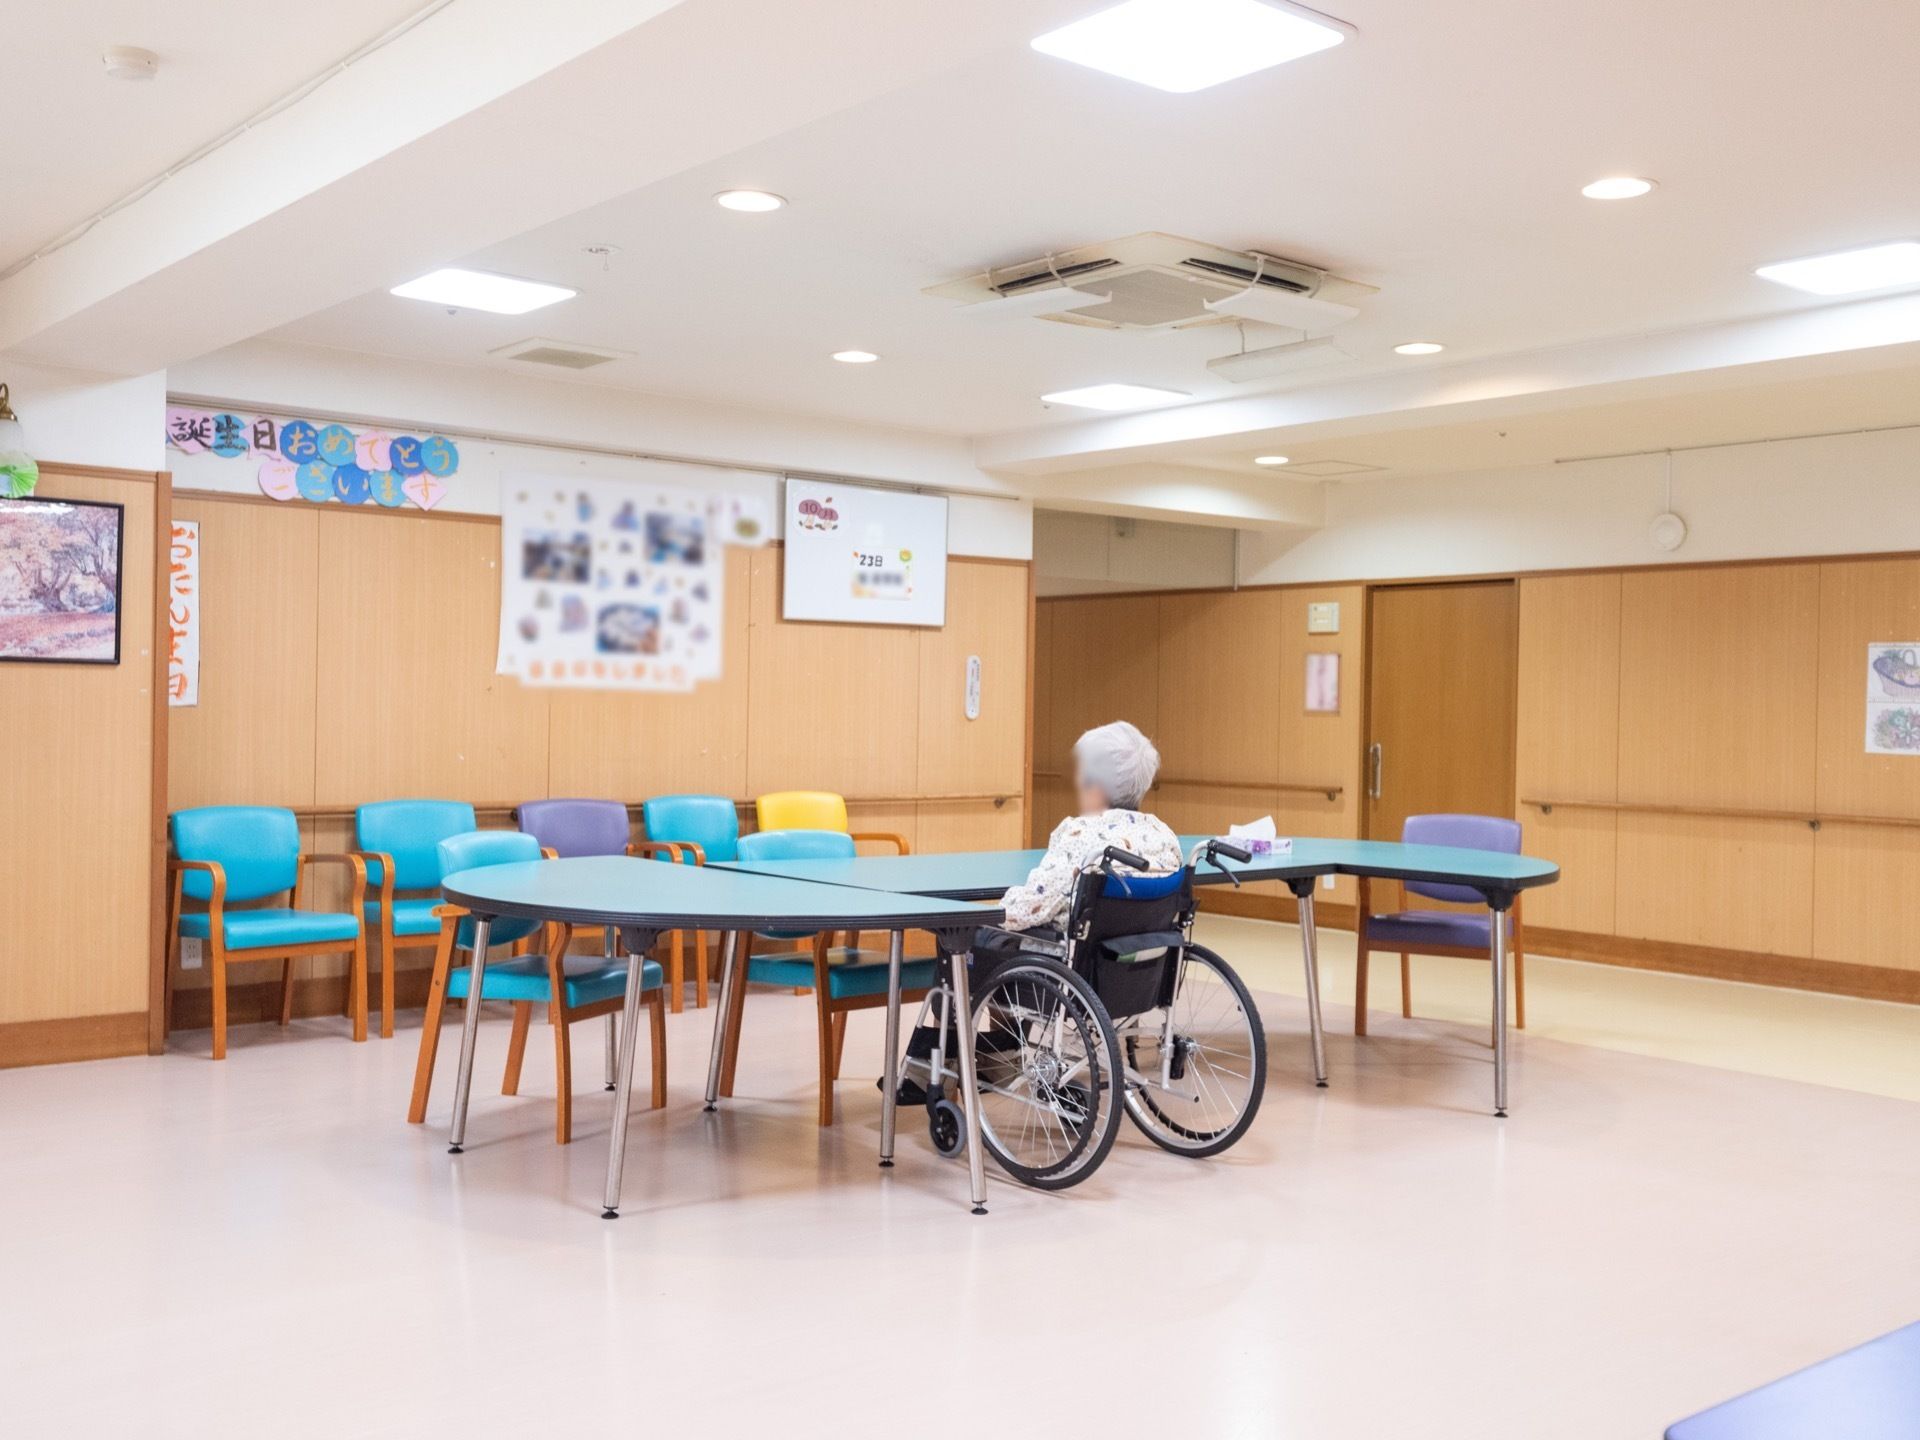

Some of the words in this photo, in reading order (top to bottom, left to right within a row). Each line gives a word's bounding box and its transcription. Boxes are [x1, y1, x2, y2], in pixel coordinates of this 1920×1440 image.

[171, 414, 451, 471] 誕生日おめでとう
[270, 463, 438, 501] ございます
[859, 554, 884, 567] 23日
